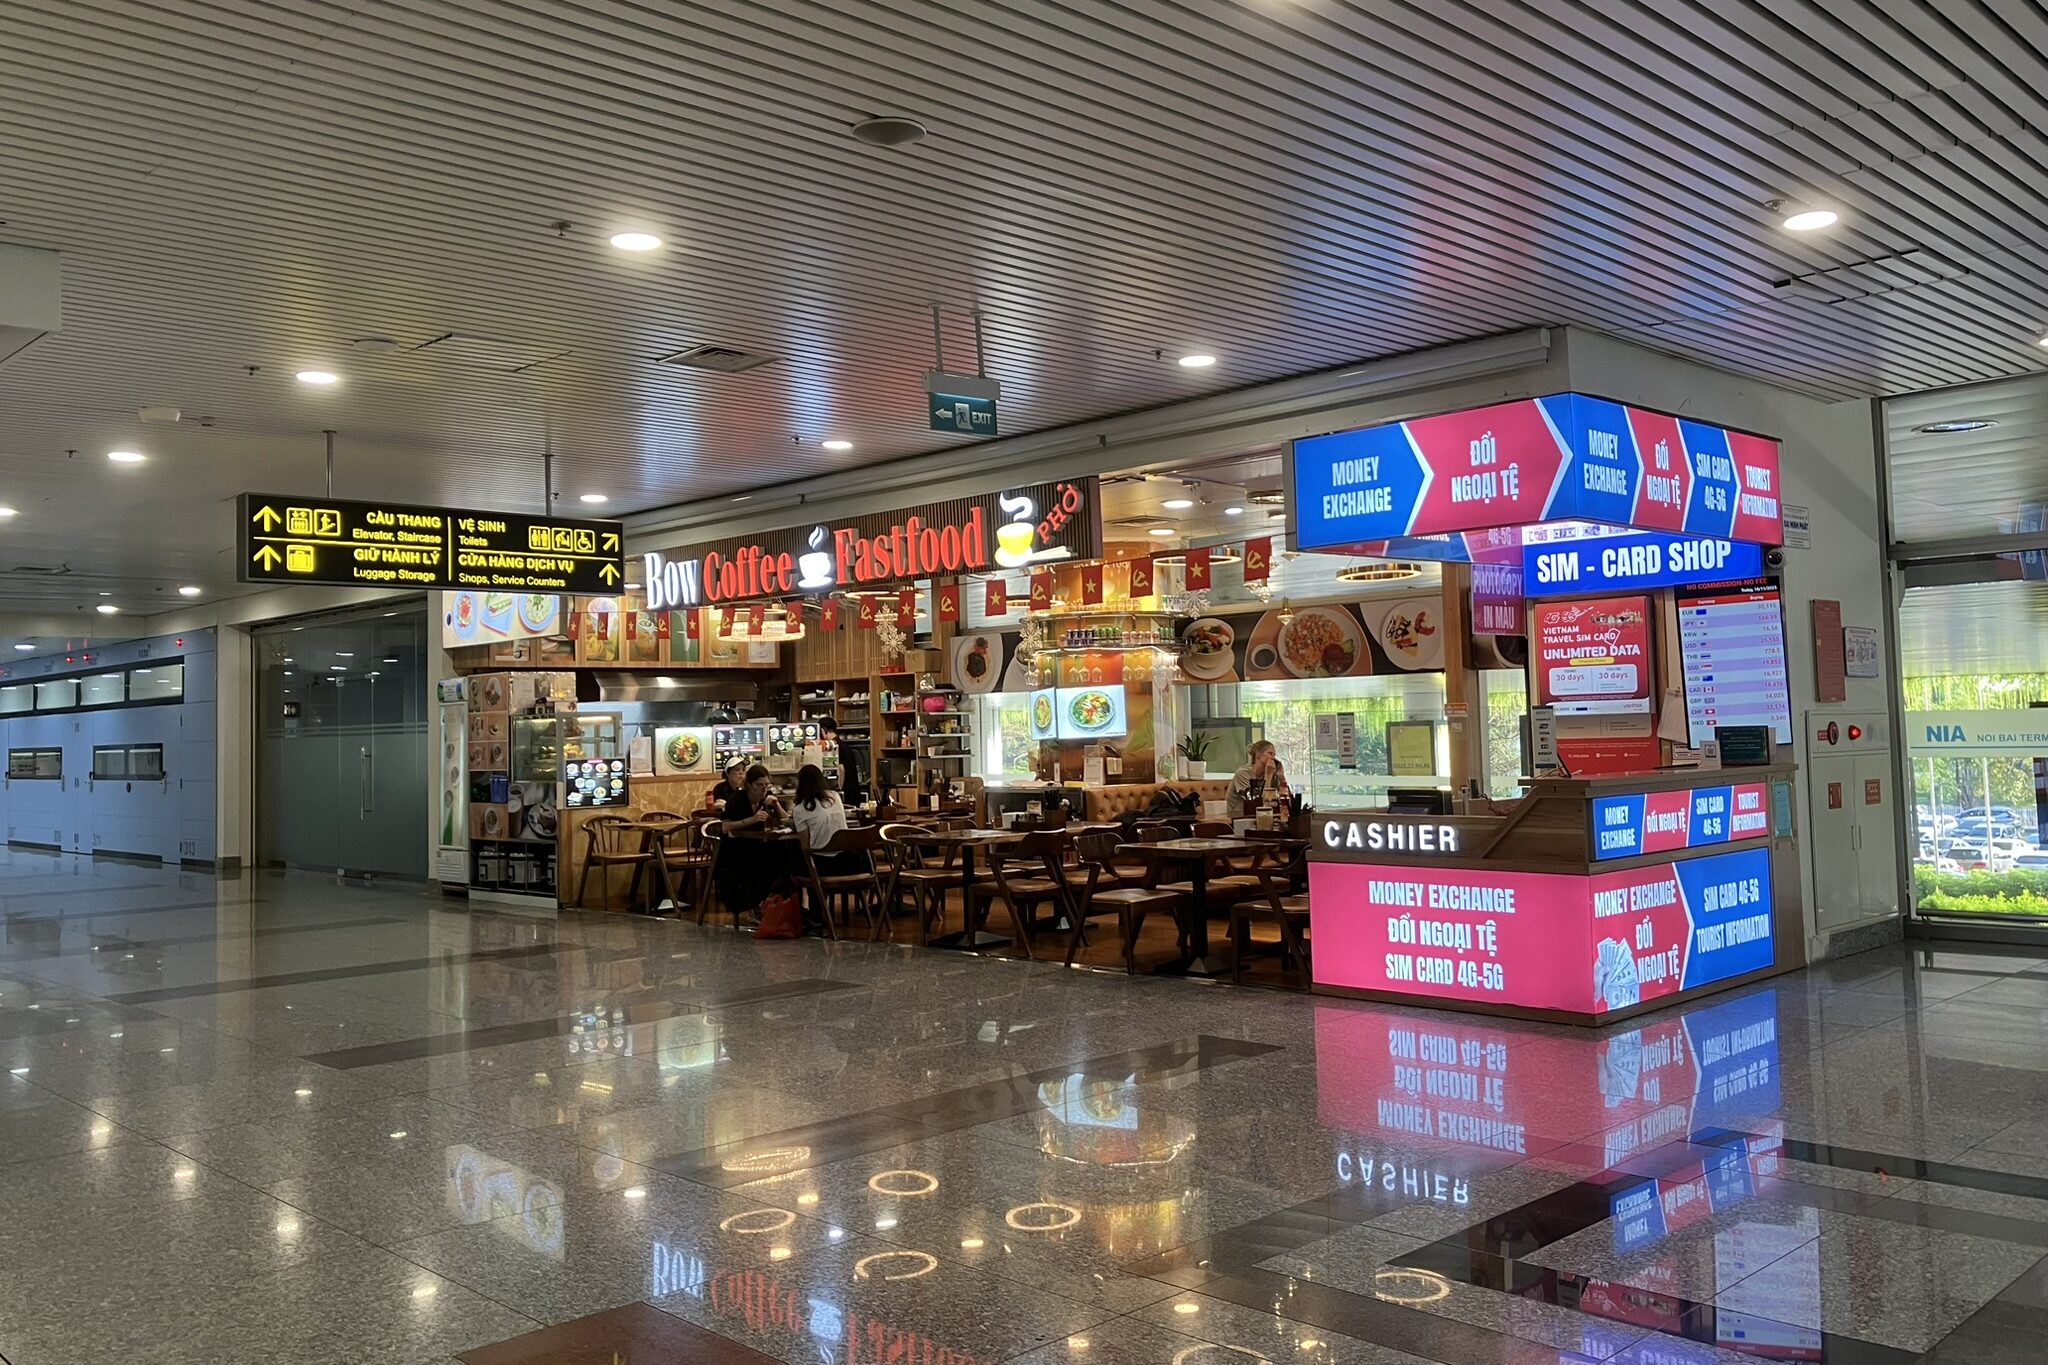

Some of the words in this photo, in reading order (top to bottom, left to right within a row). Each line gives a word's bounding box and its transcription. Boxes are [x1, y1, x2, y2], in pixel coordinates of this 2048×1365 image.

[971, 411, 992, 425] EXIT
[1469, 430, 1496, 466] ĐỔI
[1588, 429, 1618, 460] MONEY
[1654, 437, 1670, 471] ĐỔI
[1332, 455, 1380, 487] MONEY
[1583, 463, 1627, 496] EXCHANGE
[1696, 452, 1711, 478] SIM
[1712, 455, 1731, 482] CARD
[1744, 464, 1771, 491] TOURIST
[1451, 472, 1497, 504] NGOẠI
[1500, 462, 1519, 501] TỆ
[1646, 474, 1670, 508] NGOẠI
[1670, 474, 1681, 510] TỆ
[1323, 487, 1392, 519] EXCHANGE
[1704, 485, 1727, 512] 4G-5G
[1741, 493, 1778, 519] INFORMATION
[396, 513, 442, 528] THANG
[458, 517, 475, 533] VỆ
[477, 520, 506, 533] SINH
[1037, 481, 1081, 545] PHỞ
[352, 528, 395, 542] Elevator,
[397, 530, 442, 543] Staircase
[458, 535, 488, 547] Toilets
[833, 506, 986, 585] Fastfood
[353, 547, 380, 562] GIỮ
[382, 548, 420, 564] HÀNH
[422, 550, 440, 565] LÝ
[489, 554, 524, 569] HÀNG
[526, 558, 555, 572] DỊCH
[557, 560, 574, 573] VỤ
[1537, 552, 1579, 583] SIM
[1601, 544, 1661, 578] CARD
[1668, 539, 1731, 572] SHOP
[353, 567, 396, 580] Luggage
[398, 568, 436, 582] Storage
[458, 573, 490, 585] Shops,
[492, 574, 525, 586] Service
[526, 575, 566, 587] Counters
[644, 552, 698, 610] Bow
[703, 544, 793, 601] Coffee
[1473, 569, 1523, 596] PHOTOCOPY
[1755, 577, 1768, 585] FEE
[1483, 605, 1494, 628] IN
[1495, 601, 1515, 629] MÀU
[1543, 625, 1580, 635] VIETNAM
[1543, 635, 1574, 644] TRAVEL
[1576, 634, 1591, 642] SIM
[1593, 632, 1616, 641] CARD
[1543, 646, 1607, 660] UNLIMITED
[1609, 644, 1641, 656] DATA
[1567, 673, 1585, 682] days
[1599, 672, 1609, 680] 30
[1610, 671, 1629, 680] days
[1926, 725, 1967, 742] NIA
[1977, 734, 1995, 742] NOI
[2000, 733, 2017, 742] BAI
[1695, 798, 1708, 815] SIM
[1708, 795, 1724, 814] CARD
[1737, 791, 1760, 810] TOURIST
[1604, 805, 1629, 826] MONEY
[1646, 809, 1658, 833] ĐỔI
[1658, 812, 1678, 834] NGOẠI
[1678, 807, 1686, 832] TỆ
[1703, 818, 1721, 836] 4G-5G
[1732, 811, 1767, 832] INFORMATION
[1323, 820, 1457, 852] CASHIER
[1601, 828, 1636, 850] EXCHANGE
[1368, 880, 1424, 907] MONEY
[1428, 884, 1516, 913] EXCHANGE
[1594, 888, 1629, 918] MONEY
[1630, 879, 1677, 912] EXCHANGE
[1703, 886, 1719, 913] SIM
[1719, 882, 1738, 909] CARD
[1738, 878, 1760, 906] 4G-5G
[1387, 912, 1416, 944] ĐỔI
[1420, 920, 1472, 954] NGOẠI
[1476, 920, 1497, 957] TỆ
[1635, 915, 1653, 950] ĐỔI
[1695, 923, 1725, 954] TOURIST
[1725, 913, 1770, 947] INFORMATION
[1385, 953, 1413, 981] SIM
[1416, 956, 1454, 985] CARD
[1457, 960, 1504, 991] 4G-5G
[1637, 953, 1667, 984] NGOẠI
[1668, 944, 1680, 981] TỆ
